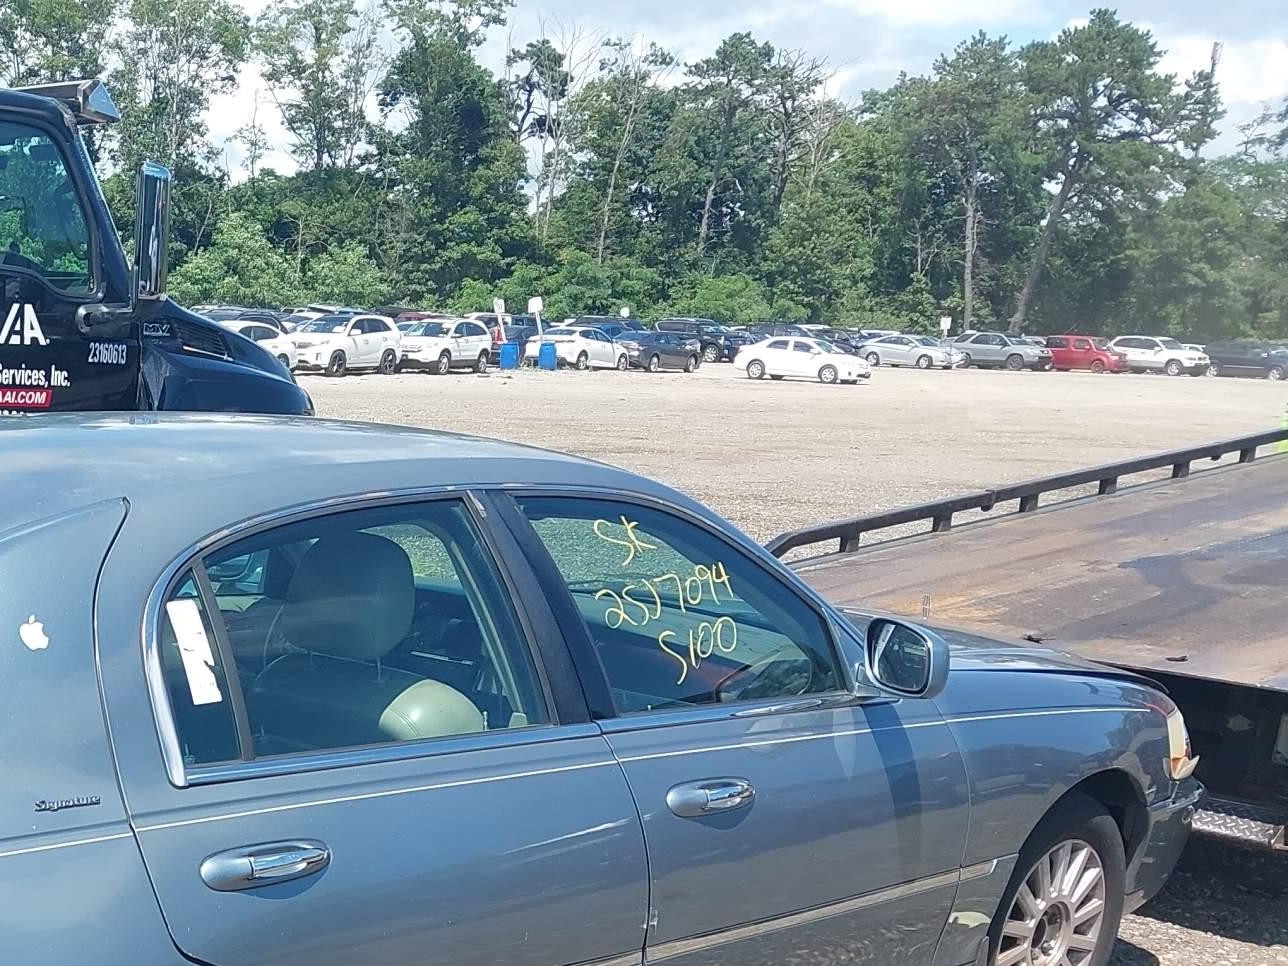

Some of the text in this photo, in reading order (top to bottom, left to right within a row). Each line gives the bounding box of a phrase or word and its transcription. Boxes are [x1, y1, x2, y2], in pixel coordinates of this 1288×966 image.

[88, 342, 127, 364] 23160613
[50, 365, 71, 387] Inc.
[34, 795, 101, 812] Signature
